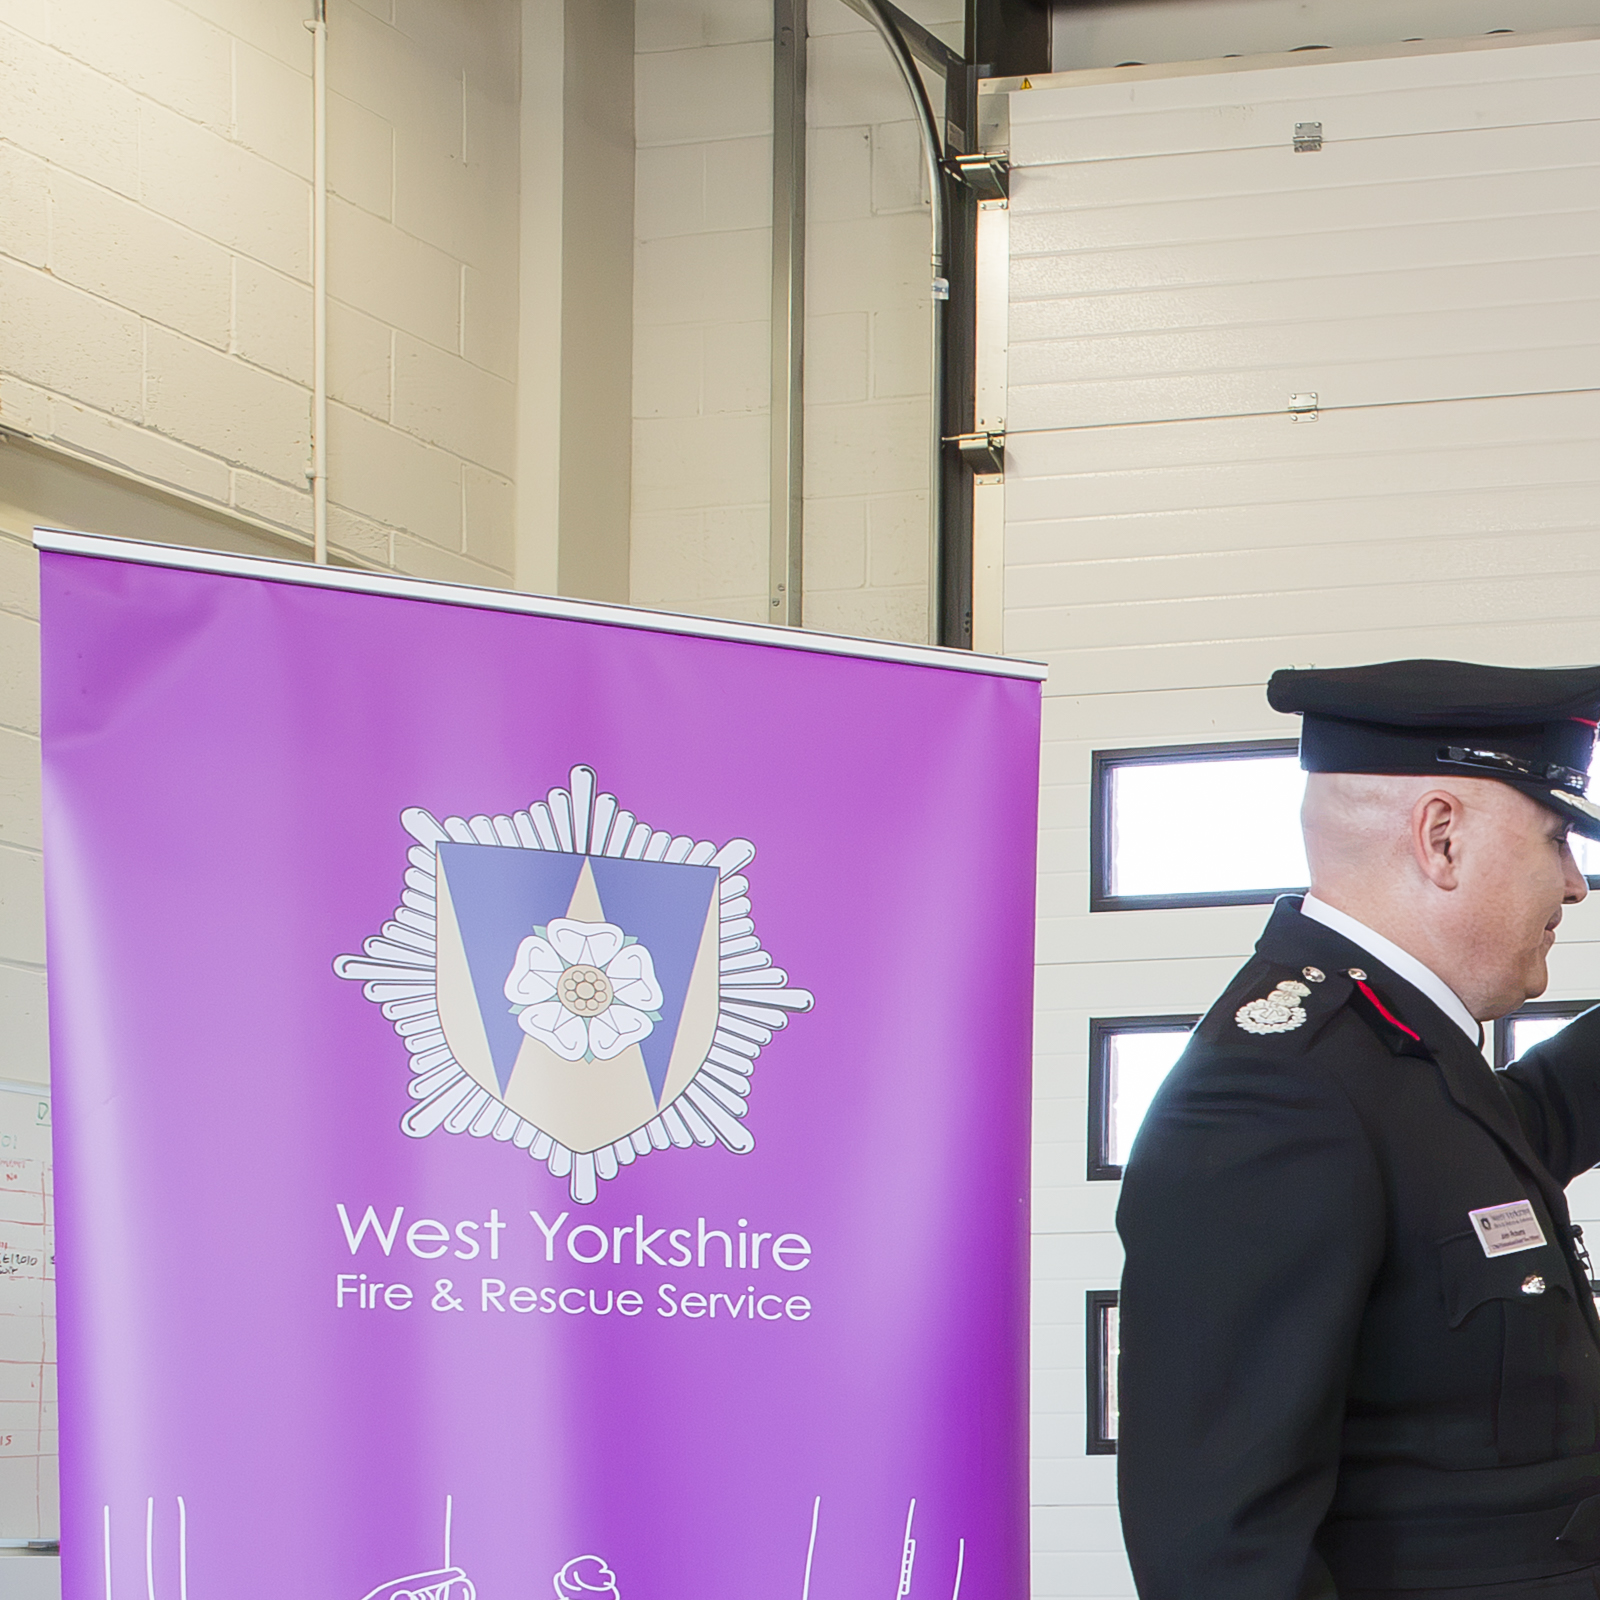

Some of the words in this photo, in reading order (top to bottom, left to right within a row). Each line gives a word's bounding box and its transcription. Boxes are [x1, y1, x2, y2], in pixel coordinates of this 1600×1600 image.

[336, 1203, 507, 1260] West
[529, 1210, 812, 1271] Yorkshire
[336, 1273, 414, 1311] Fire
[430, 1278, 465, 1312] &
[480, 1278, 643, 1316] Rescue
[656, 1283, 812, 1321] Service
